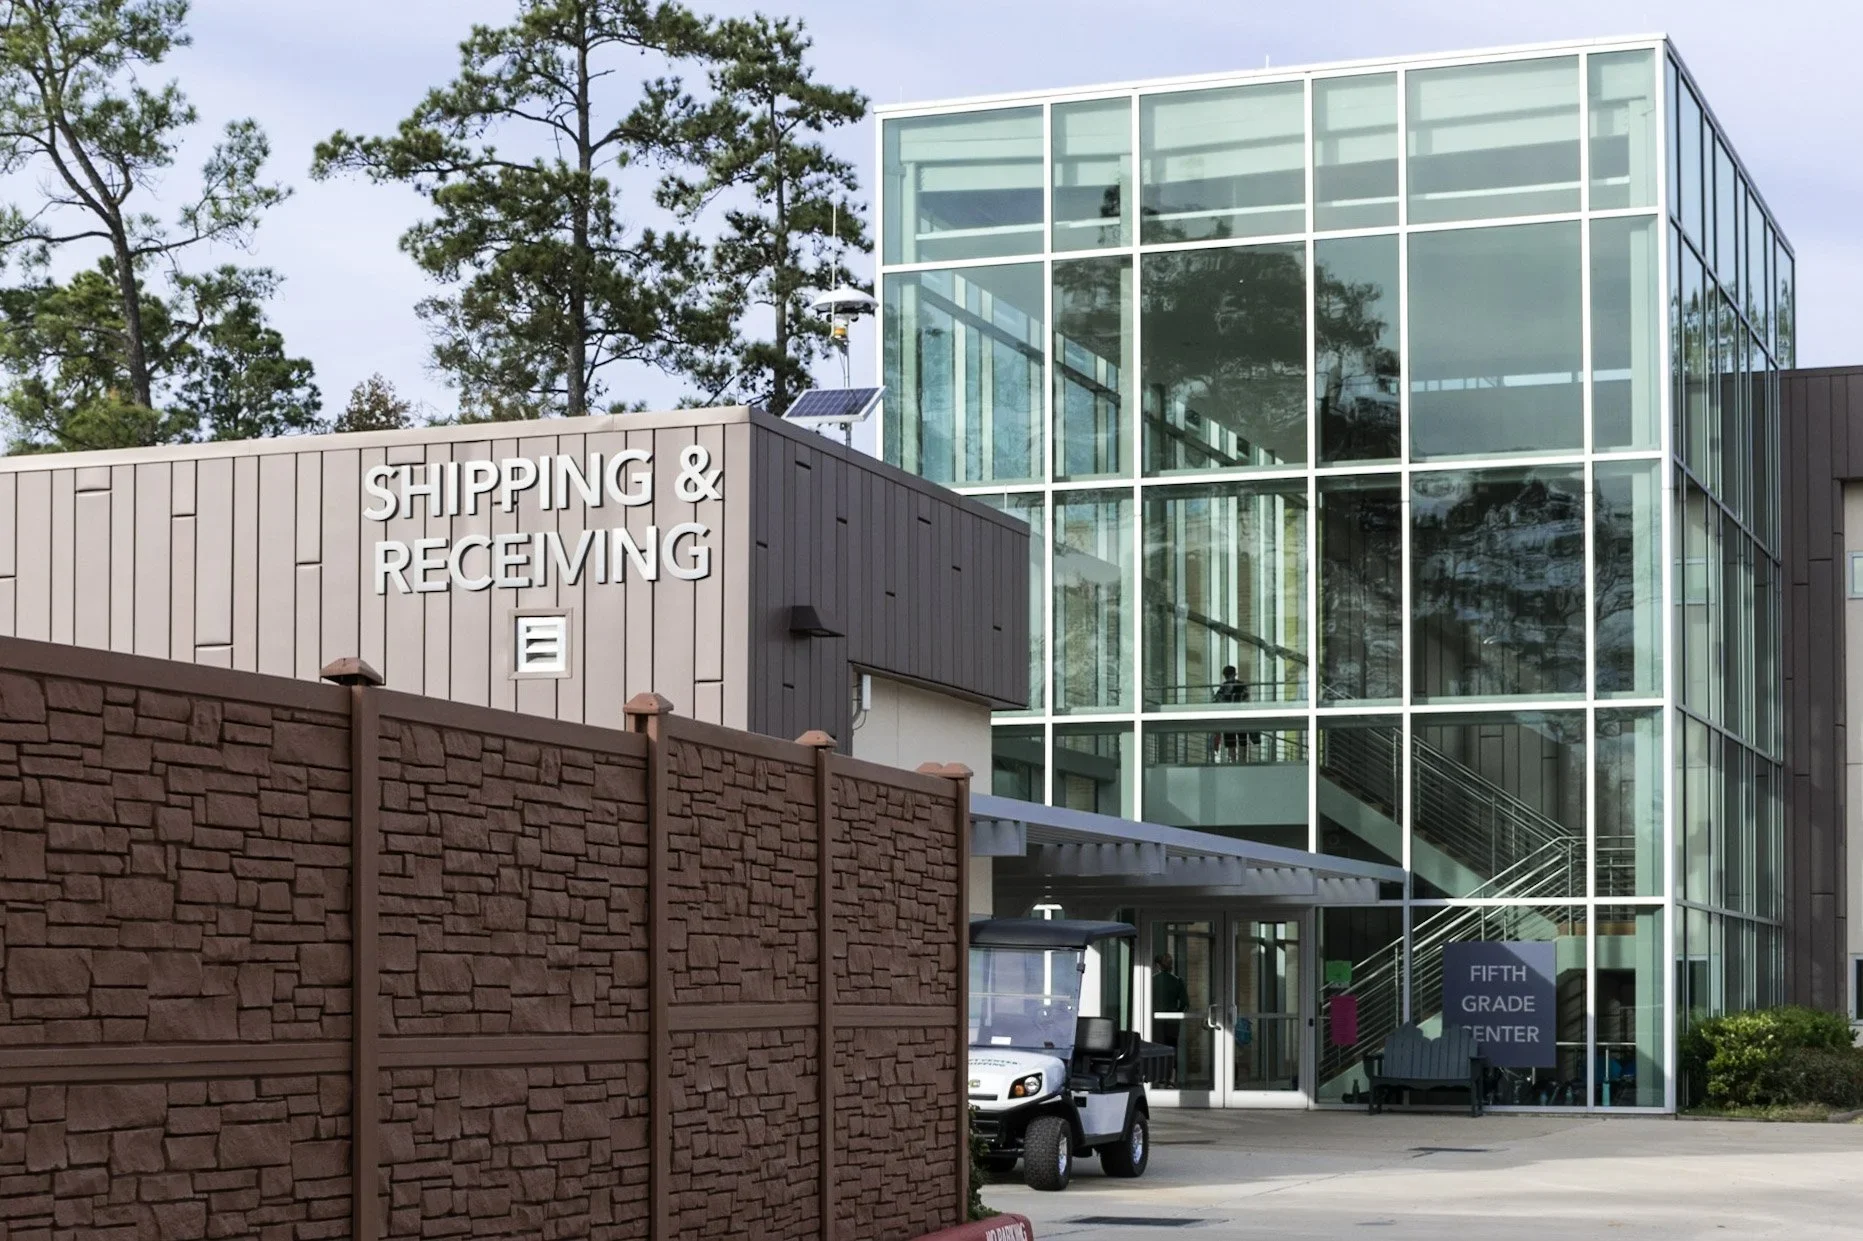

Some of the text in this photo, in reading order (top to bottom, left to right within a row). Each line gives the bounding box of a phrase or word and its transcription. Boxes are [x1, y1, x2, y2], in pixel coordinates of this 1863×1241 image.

[363, 444, 724, 521] SHIPPING &
[374, 522, 711, 595] RECEIVING
[1470, 965, 1526, 982] FIFTH
[1461, 995, 1536, 1013] GRADE
[1462, 1025, 1540, 1043] ENTER
